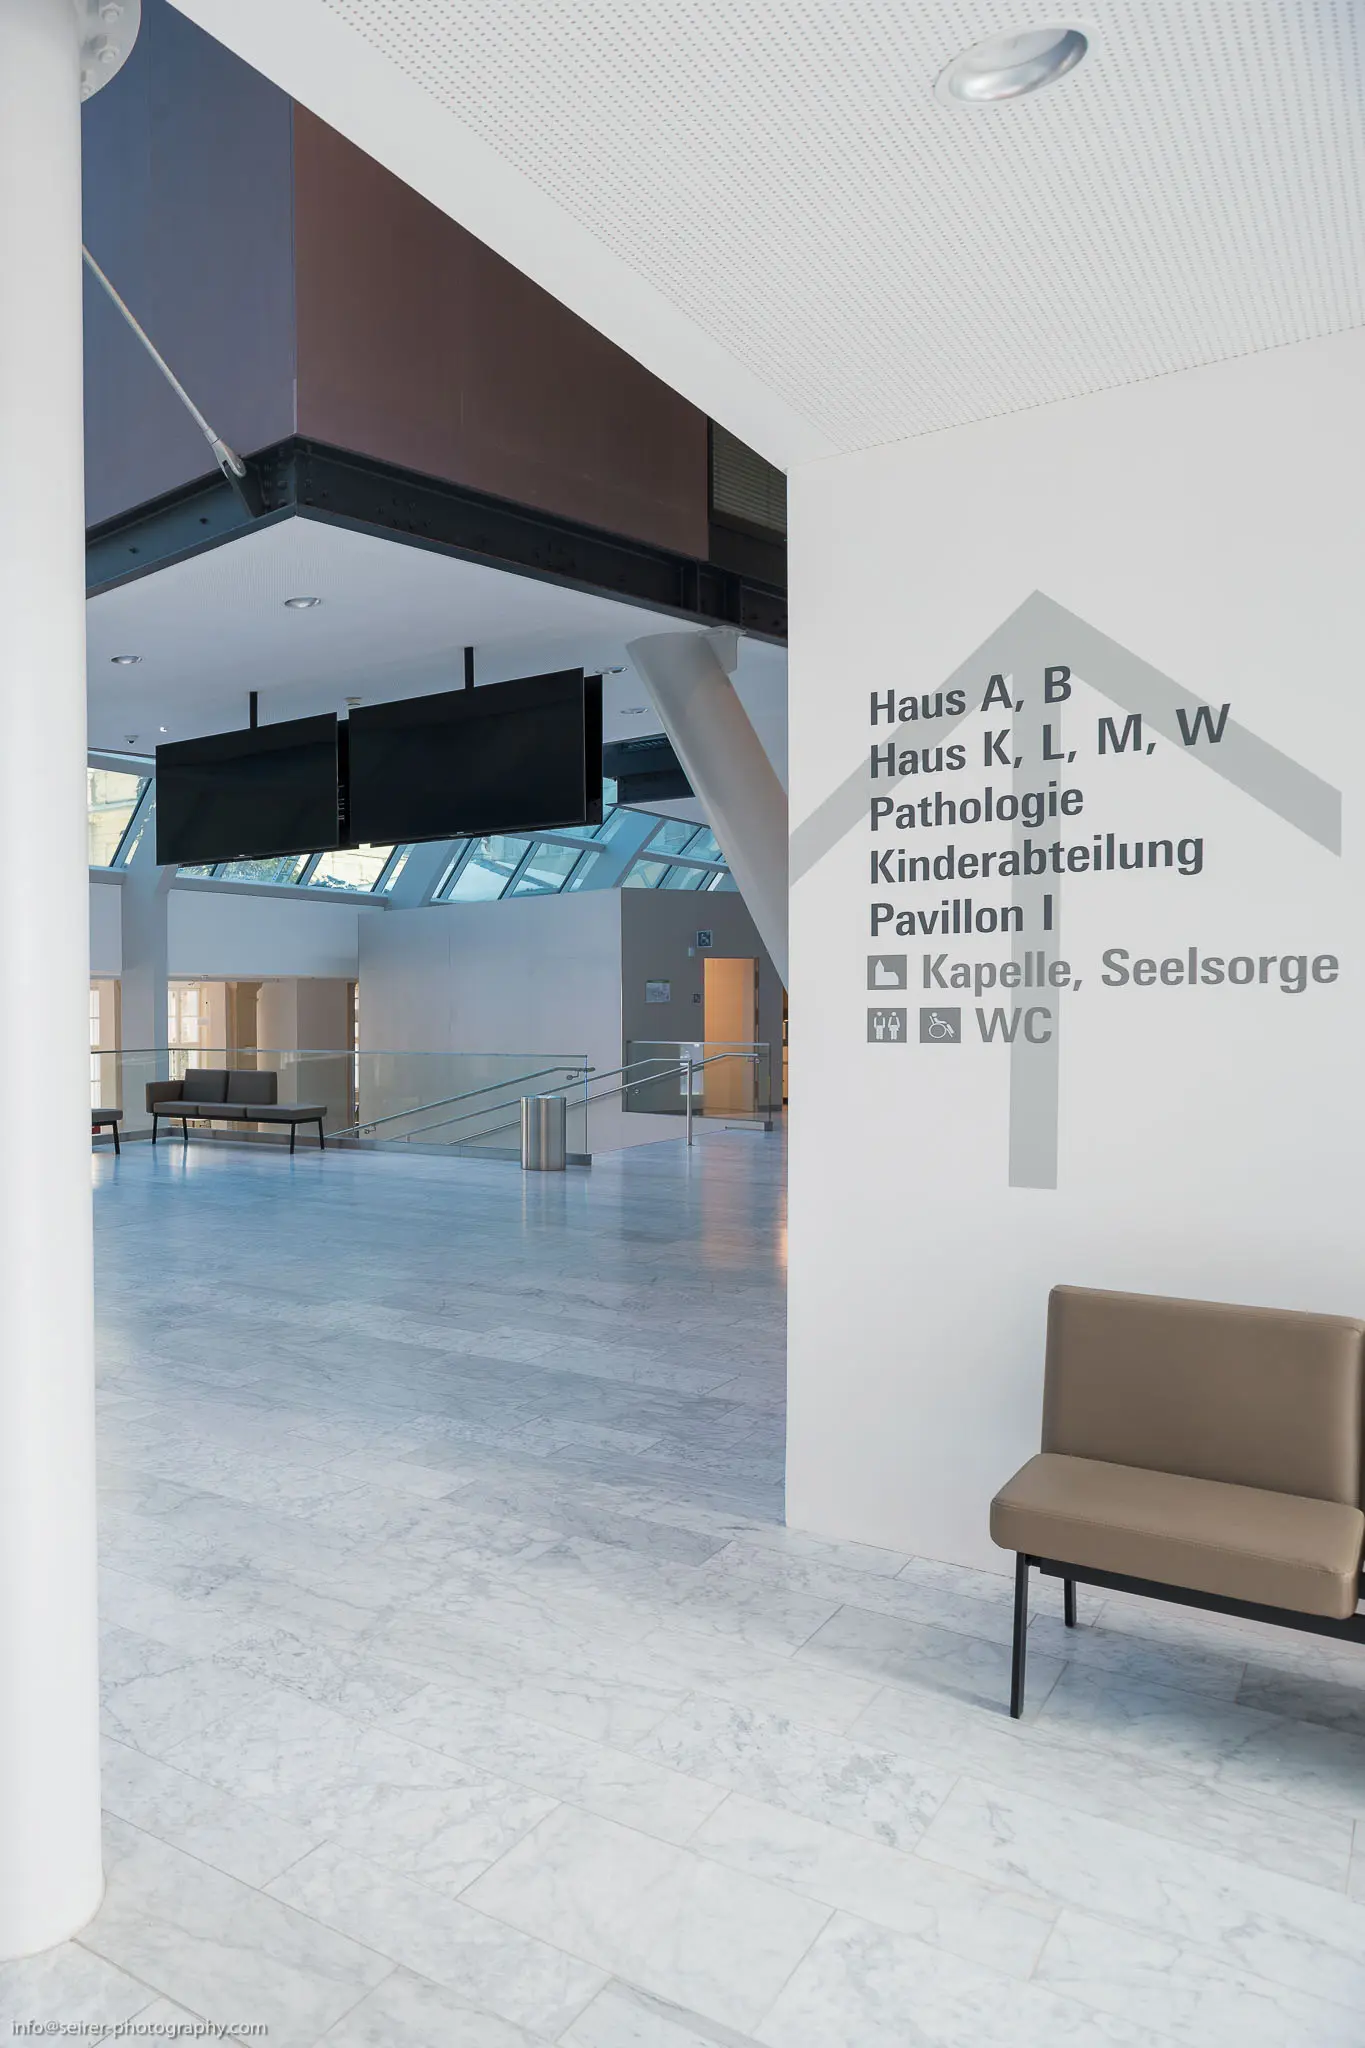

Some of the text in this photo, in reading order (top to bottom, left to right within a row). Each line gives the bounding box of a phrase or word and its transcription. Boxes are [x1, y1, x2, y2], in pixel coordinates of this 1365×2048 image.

[871, 665, 1072, 725] Haus A, B
[871, 703, 1230, 779] Haus K, L, M, W
[871, 780, 1084, 831] Pathologie
[871, 833, 1204, 885] Kinderabteilung
[871, 894, 1053, 937] Pavillon I
[922, 946, 1339, 997] Kapelle, Seelsorge
[975, 1006, 1052, 1044] WC
